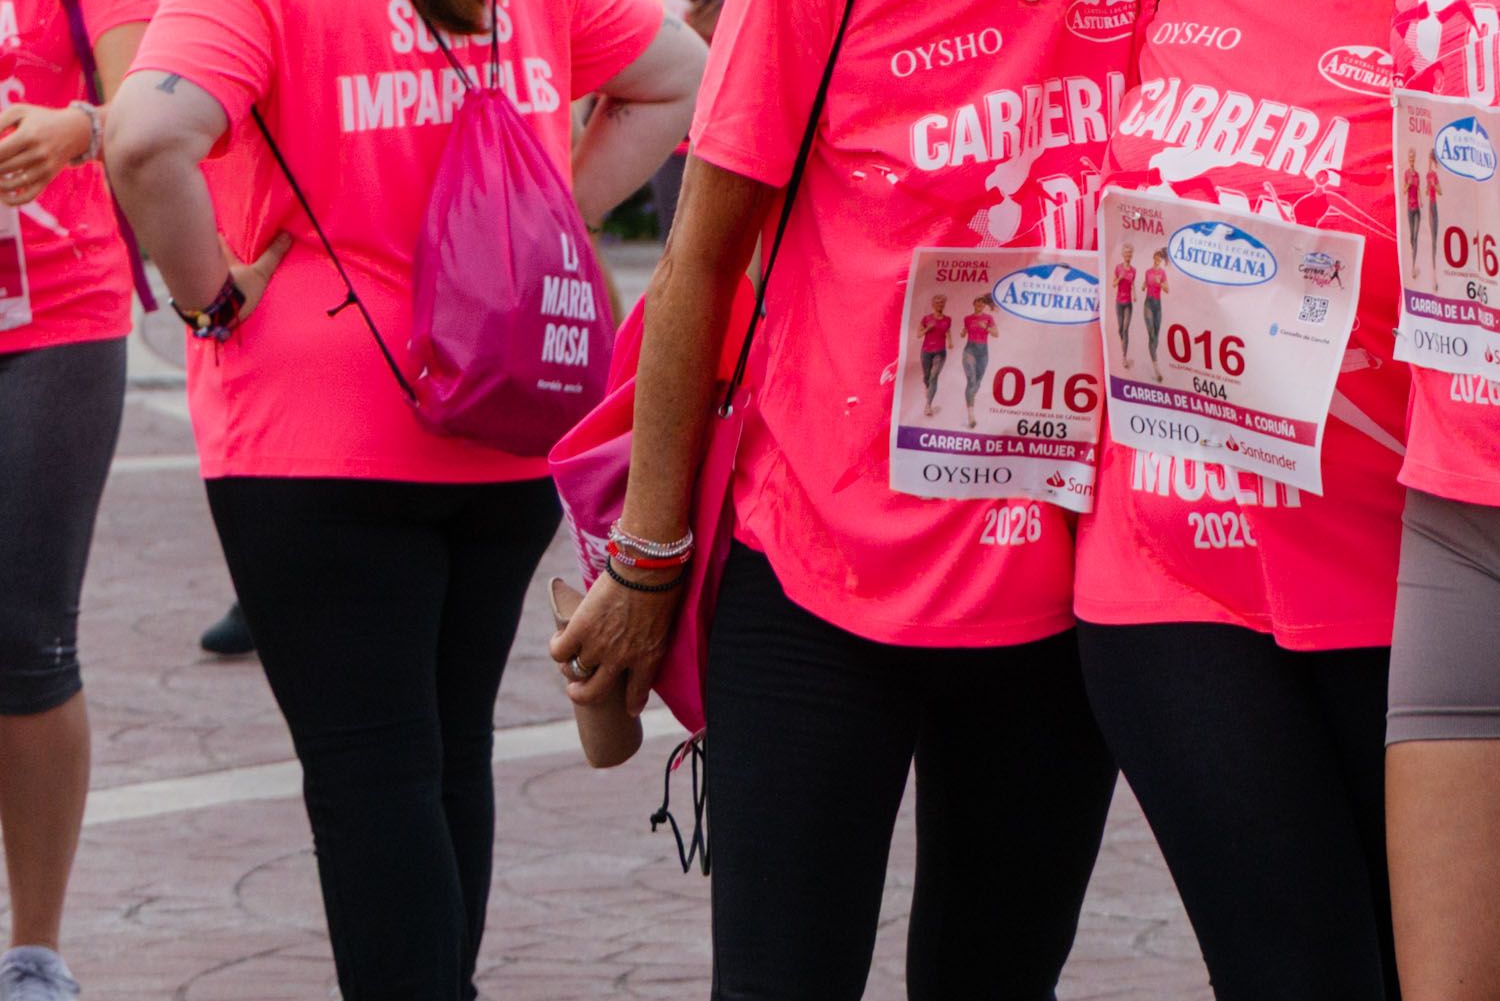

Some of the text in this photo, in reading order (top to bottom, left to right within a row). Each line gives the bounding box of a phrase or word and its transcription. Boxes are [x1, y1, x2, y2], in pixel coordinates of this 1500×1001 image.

[1152, 22, 1242, 50] OYSHO
[891, 28, 1003, 78] OYSHO
[1119, 77, 1350, 186] CARRERA
[1122, 215, 1165, 236] SUMA
[1174, 237, 1266, 278] ASTURIANA
[1443, 226, 1499, 277] 016
[936, 269, 989, 283] SUMA
[1444, 306, 1457, 319] DE
[1460, 307, 1475, 321] LA
[542, 323, 588, 366] ROSA
[1167, 324, 1246, 377] 016
[1414, 329, 1468, 357] OYSHO
[992, 366, 1098, 414] 016
[1193, 377, 1227, 400] 6404
[1123, 385, 1296, 438] CARRERA DE LA MUJER A CORUÑA
[1017, 419, 1067, 439] 6403
[1131, 415, 1199, 444] OYSHO
[919, 433, 981, 452] CARRERA
[986, 440, 1003, 452] DE
[1007, 442, 1024, 453] LA
[1029, 443, 1075, 457] MUJER
[1240, 441, 1297, 471] Santander
[923, 464, 1012, 484] OYSHO
[979, 504, 1042, 545] 2026
